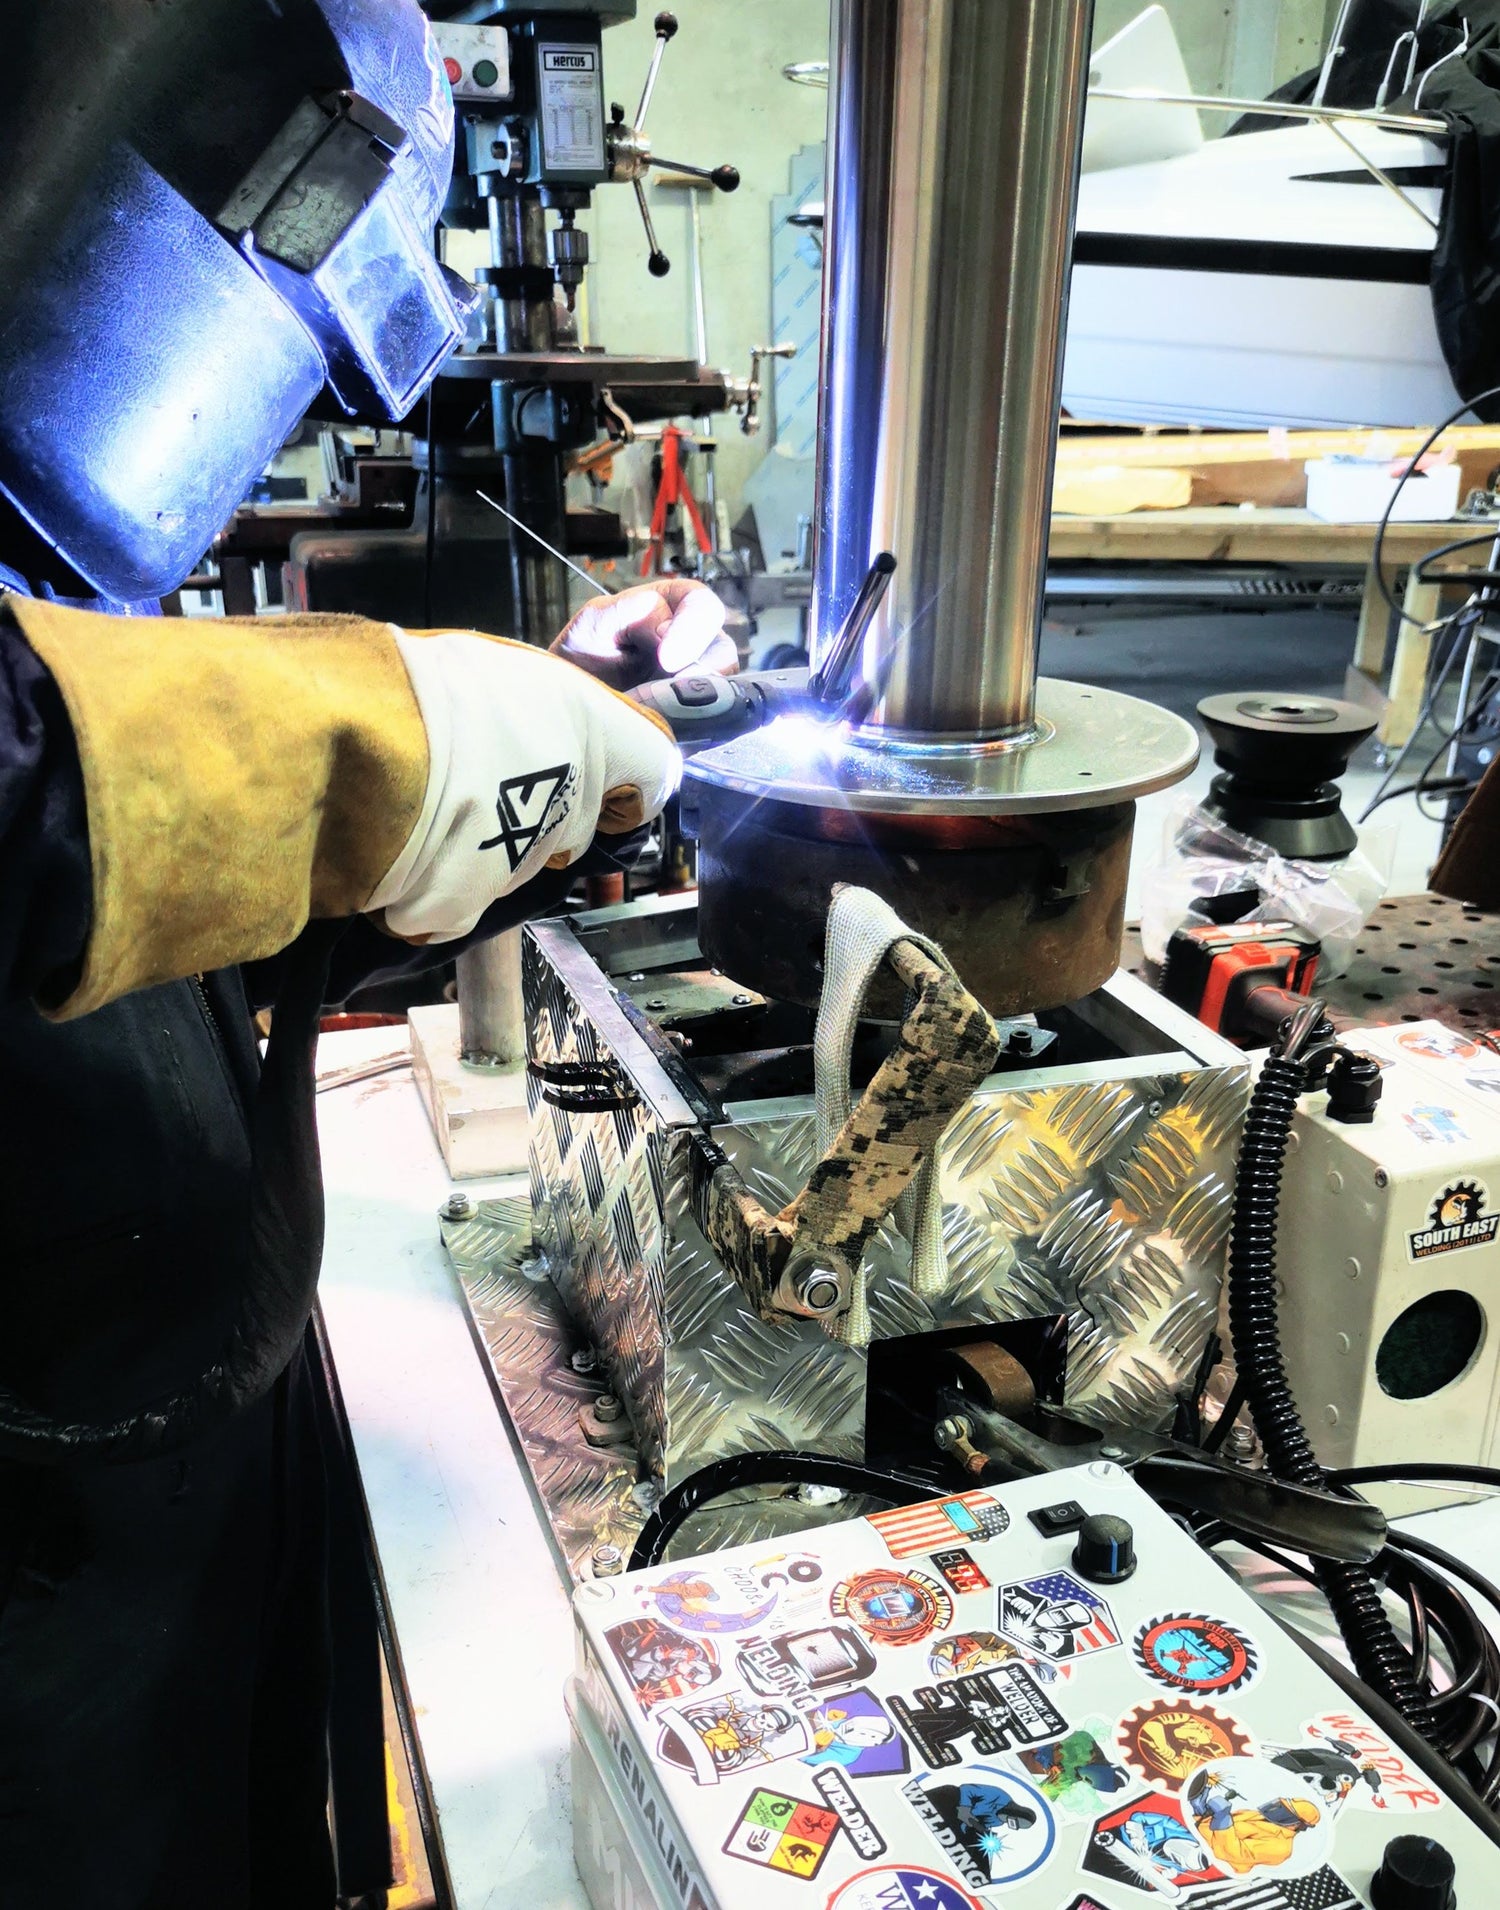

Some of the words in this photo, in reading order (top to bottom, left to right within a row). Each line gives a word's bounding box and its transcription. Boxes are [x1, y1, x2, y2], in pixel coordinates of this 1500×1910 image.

[553, 56, 586, 67] Hercus
[1413, 1226, 1461, 1249] SOUTH
[1463, 1217, 1498, 1237] EAST
[1415, 1243, 1452, 1257] WELDING
[1477, 1233, 1492, 1242] LTD
[724, 1566, 764, 1605] CHOOS
[908, 1571, 951, 1630] WELDING
[1008, 1667, 1025, 1681] THE
[1000, 1682, 1040, 1725] WELDER
[1322, 1715, 1440, 1809] WELDER
[817, 1770, 882, 1857] WELDER
[901, 1779, 990, 1888] WELDING
